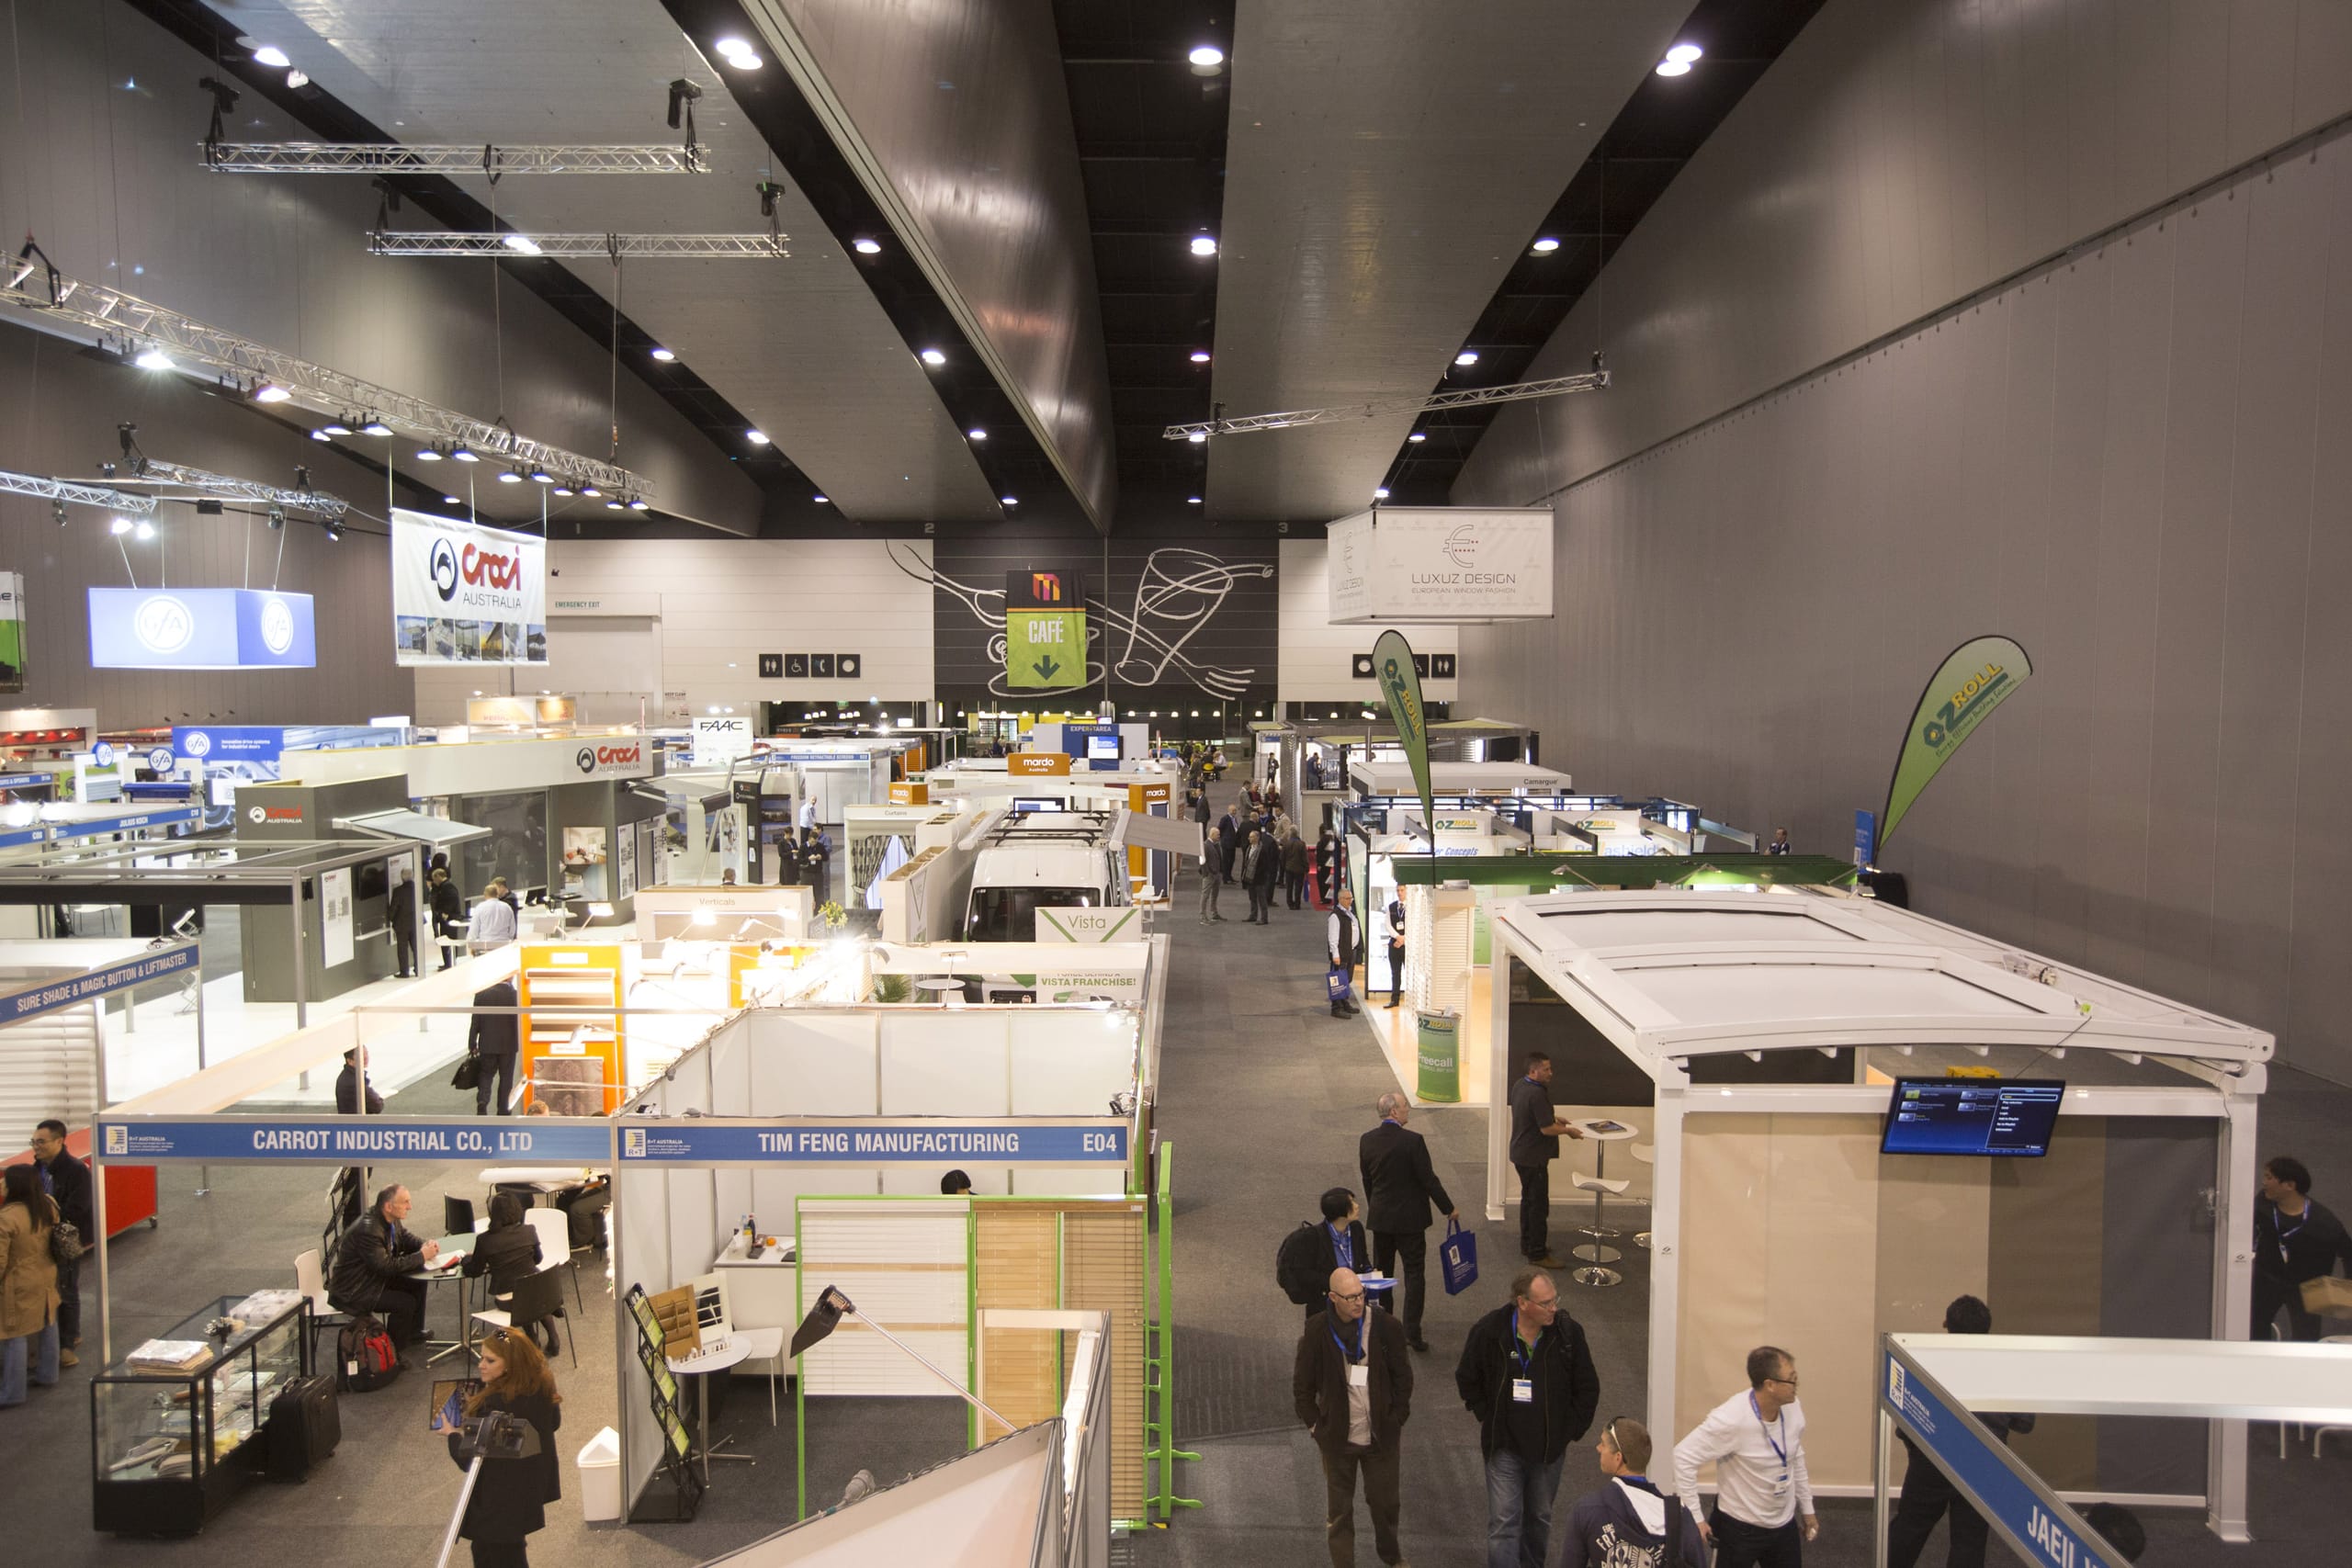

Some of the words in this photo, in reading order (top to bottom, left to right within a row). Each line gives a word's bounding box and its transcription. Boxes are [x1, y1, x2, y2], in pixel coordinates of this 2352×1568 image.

[924, 522, 934, 534] 2
[1278, 522, 1288, 534] 3
[1411, 573, 1459, 584] LUXUZ
[1464, 573, 1516, 584] DESIGN
[463, 592, 522, 610] AUSTRALIA
[555, 601, 587, 609] EMERGENCY
[588, 601, 600, 609] EXIT
[1028, 616, 1064, 644] CAFÉ
[700, 720, 743, 732] FAAC
[1023, 757, 1055, 766] mardo
[598, 763, 640, 773] AUSTRALIA
[892, 788, 909, 796] mardo
[1146, 788, 1166, 797] mardo
[698, 897, 736, 906] Verticals
[1067, 915, 1106, 930] Vista
[17, 998, 41, 1012] SURE
[42, 989, 72, 1005] SHADE
[73, 985, 79, 997] &
[81, 976, 107, 994] MAGIC
[107, 969, 137, 987] BUTTON
[138, 966, 144, 976] &
[145, 952, 187, 976] LIFTMASTER
[1041, 977, 1069, 987] VISTA
[1073, 977, 1136, 987] FRANCHISE!
[253, 1130, 331, 1150] CARROT
[336, 1131, 450, 1151] INDUSTRIAL
[456, 1132, 493, 1154] CO.,
[499, 1132, 533, 1151] LTD
[758, 1133, 793, 1153] TIM
[799, 1133, 849, 1153] FENG
[855, 1133, 1020, 1153] MANUFACTURING
[1082, 1133, 1117, 1153] E04
